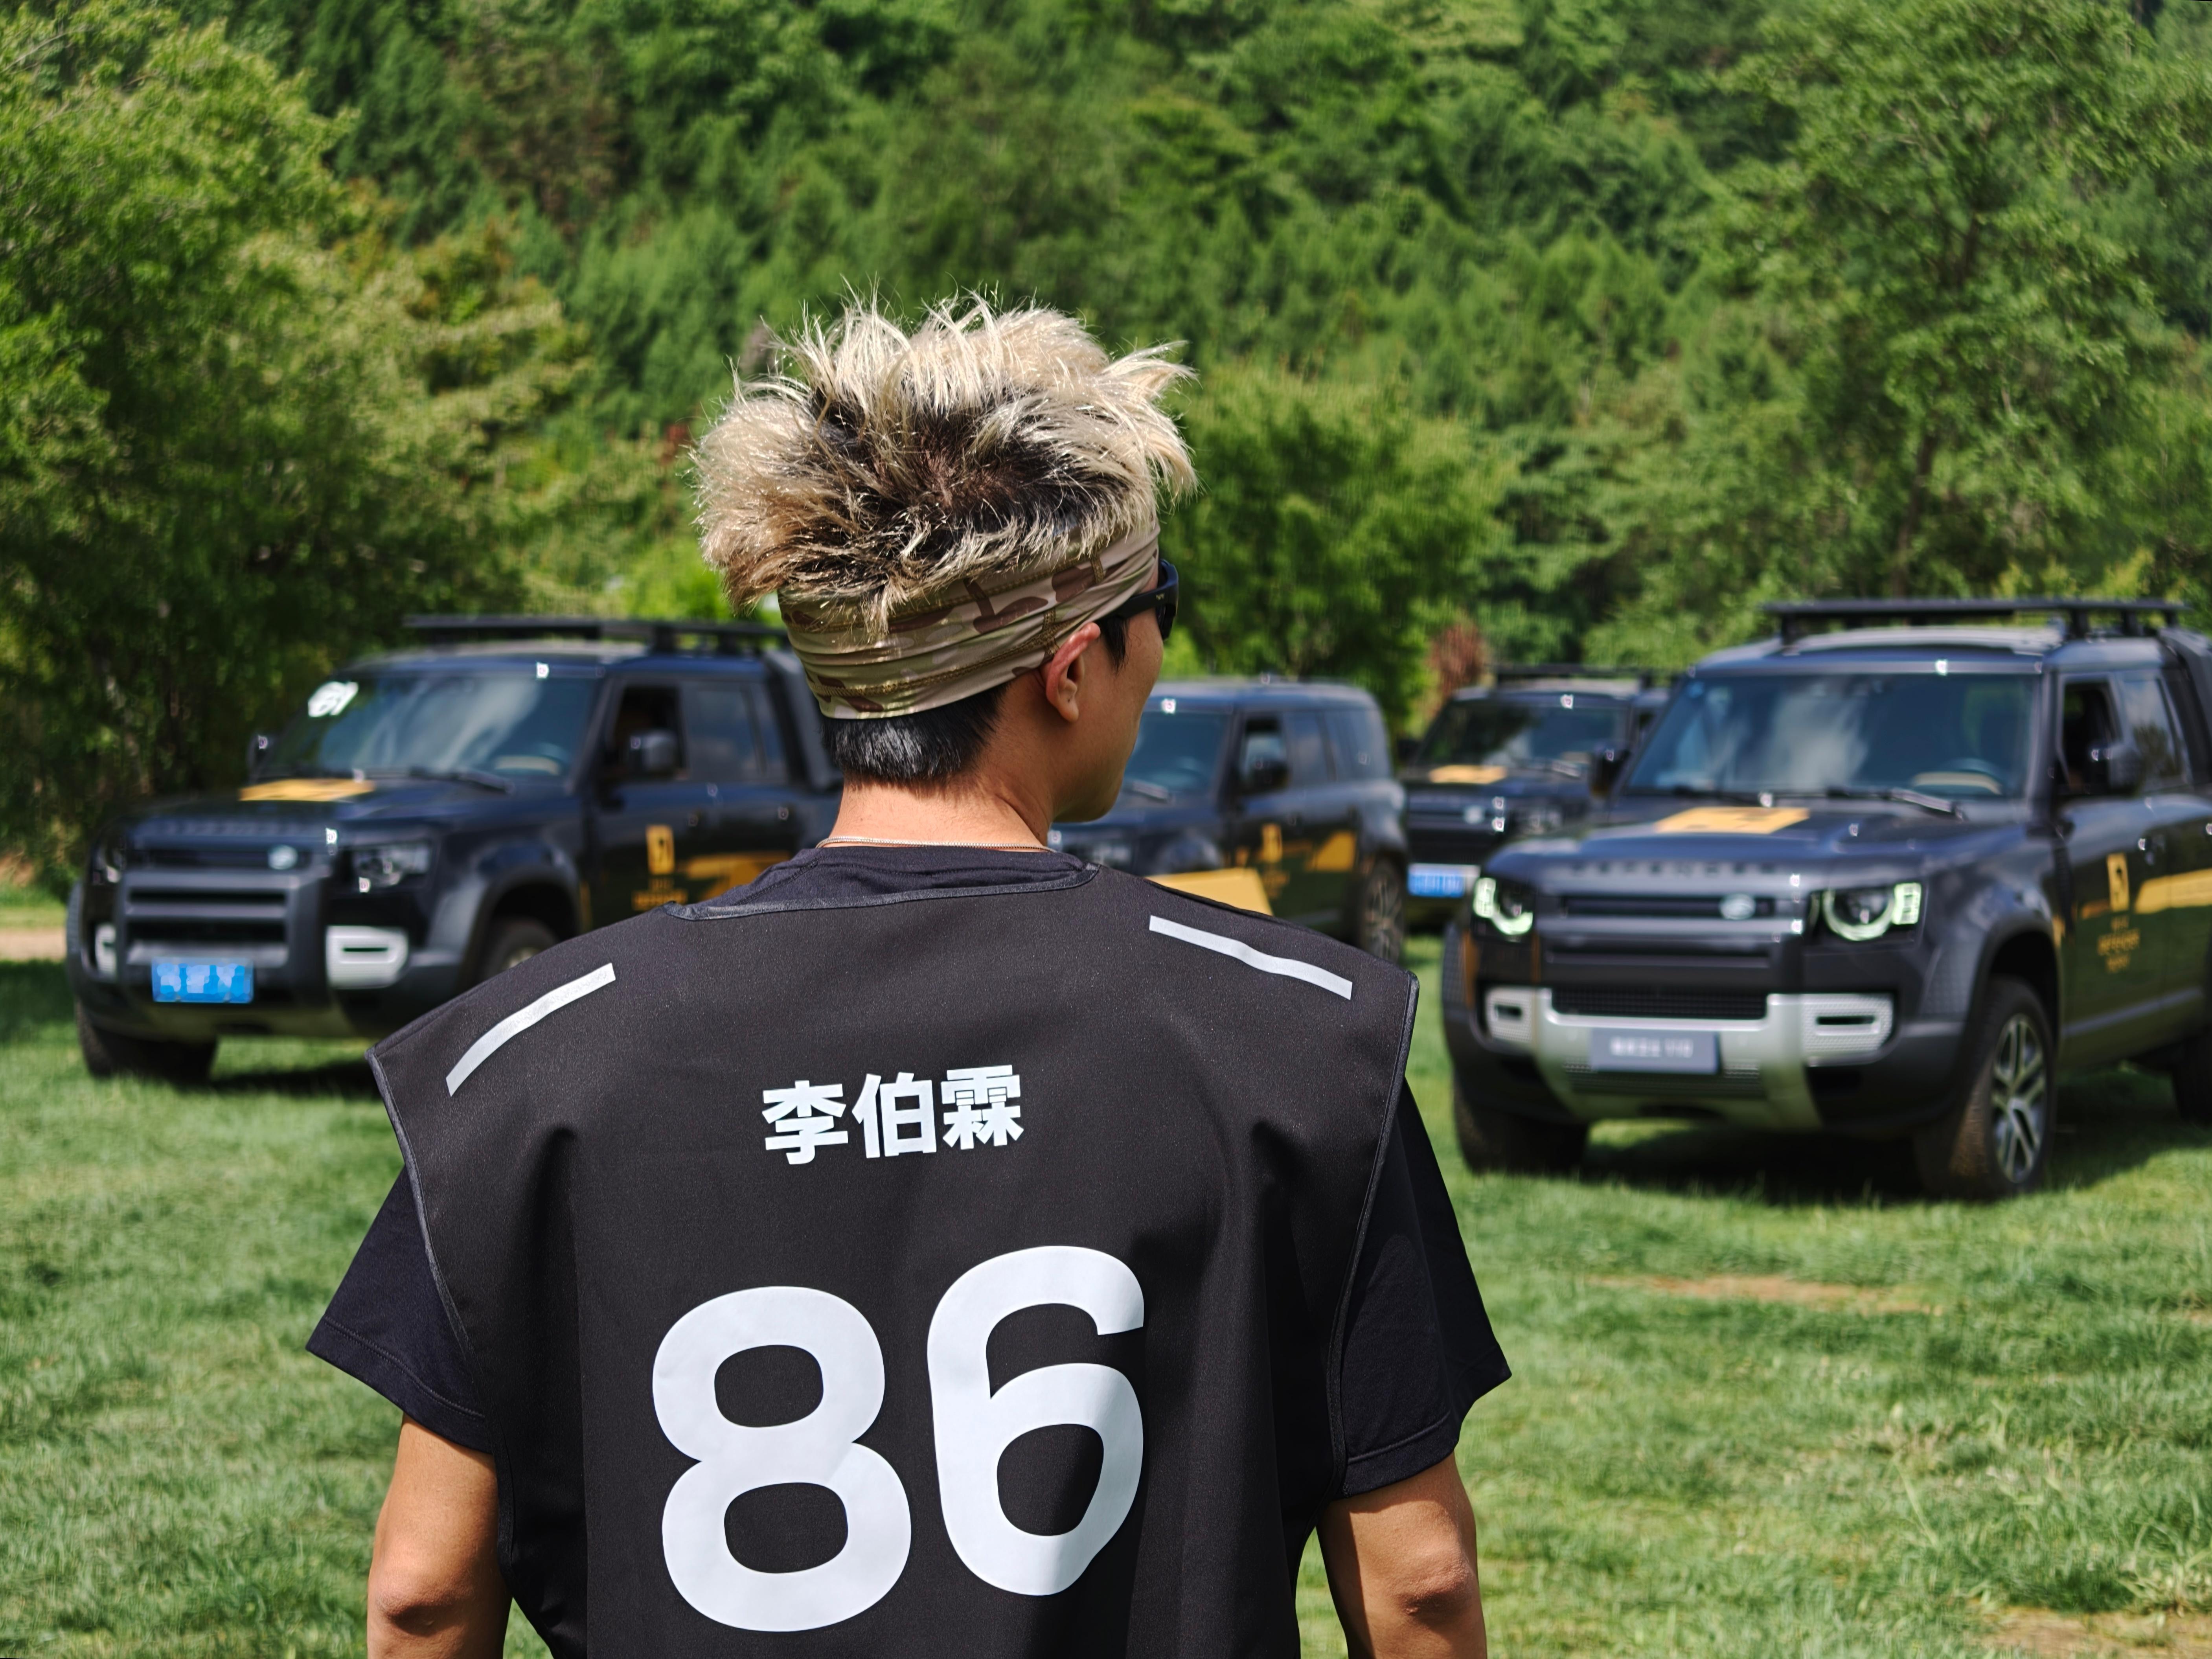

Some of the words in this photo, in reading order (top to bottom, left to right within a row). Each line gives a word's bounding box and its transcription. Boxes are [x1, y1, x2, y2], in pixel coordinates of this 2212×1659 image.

[762, 1065, 1024, 1164] 李伯霖
[653, 1245, 1144, 1632] 86
